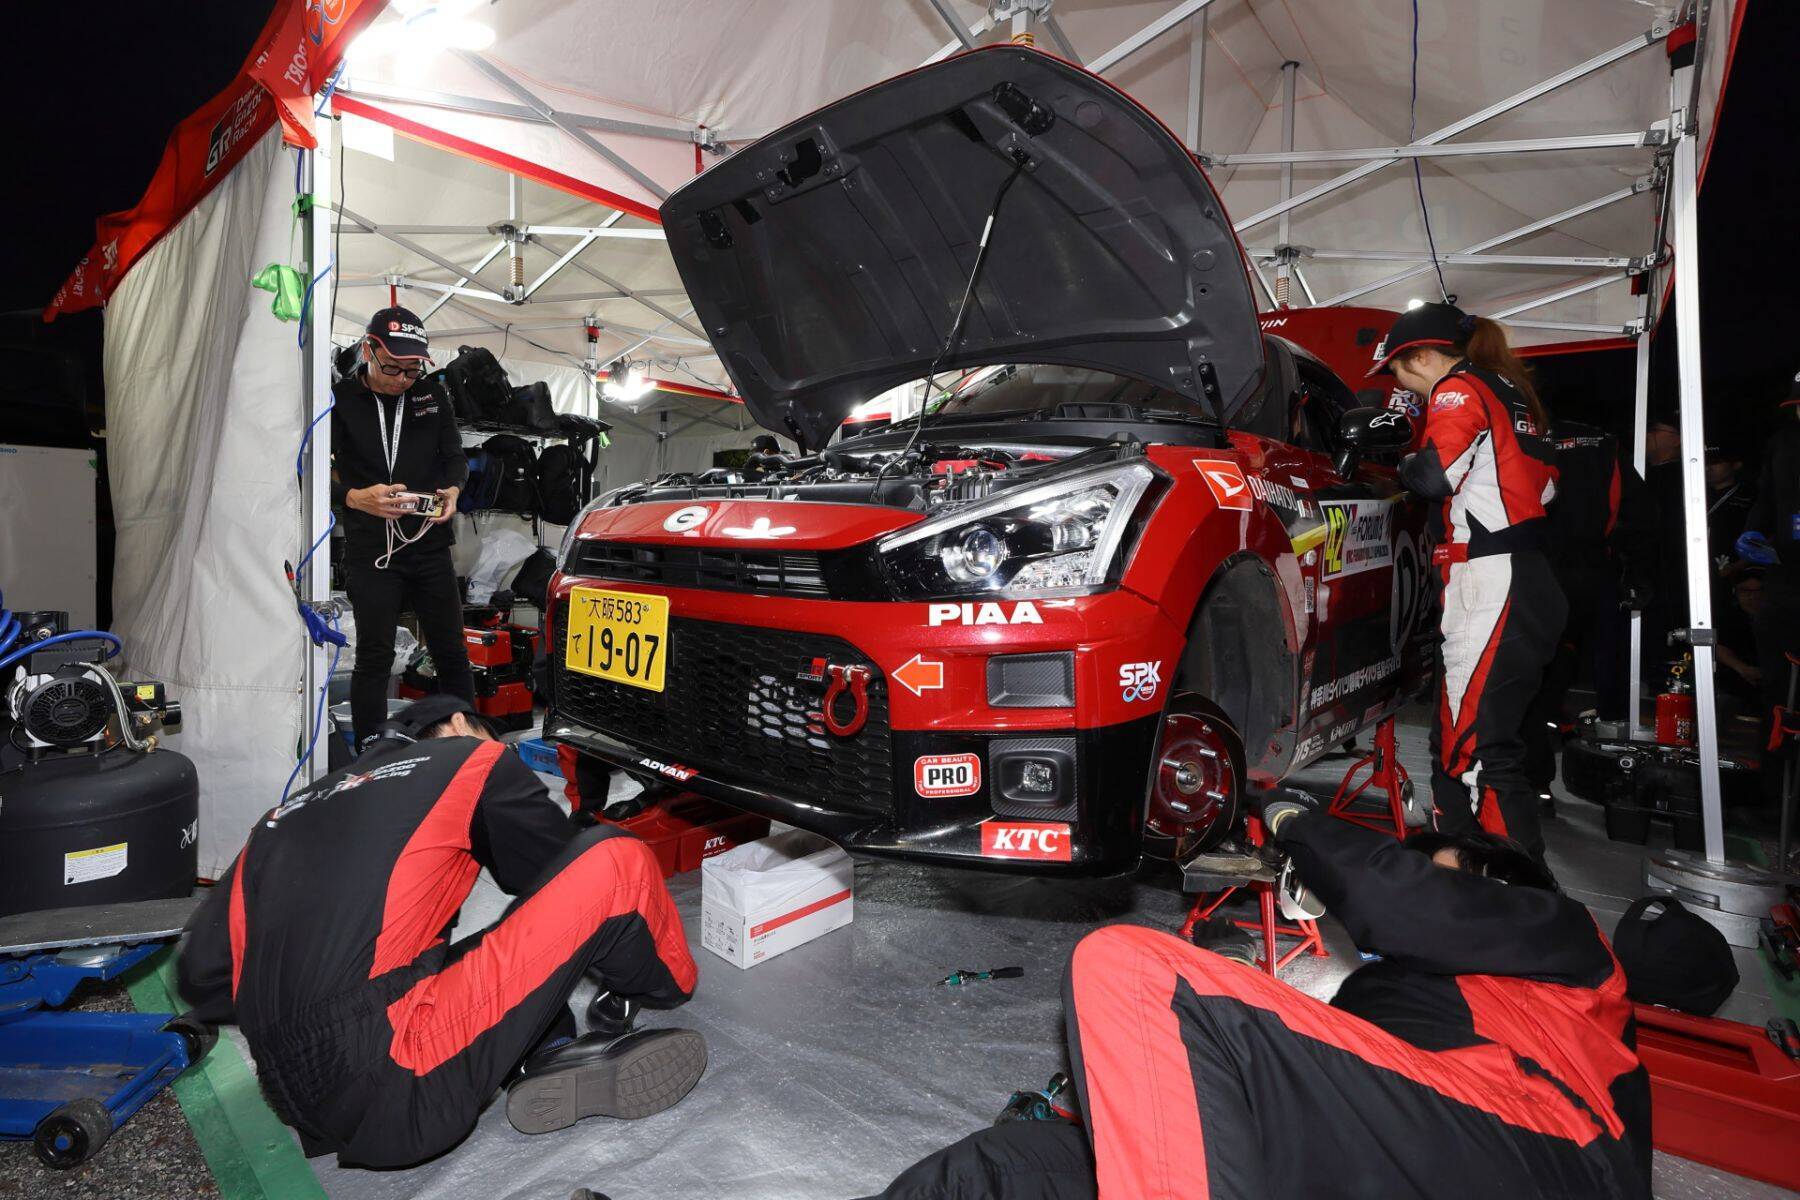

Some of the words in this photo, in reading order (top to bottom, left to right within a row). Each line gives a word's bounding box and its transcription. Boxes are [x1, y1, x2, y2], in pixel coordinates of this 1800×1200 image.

[1247, 475, 1298, 512] DAIHATSU
[1325, 507, 1348, 574] 42
[588, 597, 642, 625] 大阪583
[928, 601, 1044, 627] PIAA
[572, 633, 582, 655] て
[587, 624, 660, 681] 19-07
[1119, 660, 1162, 687] SPK
[639, 757, 692, 781] ADVAN
[941, 756, 974, 764] BEAUTY
[928, 765, 967, 786] PRO
[992, 828, 1059, 853] KTC
